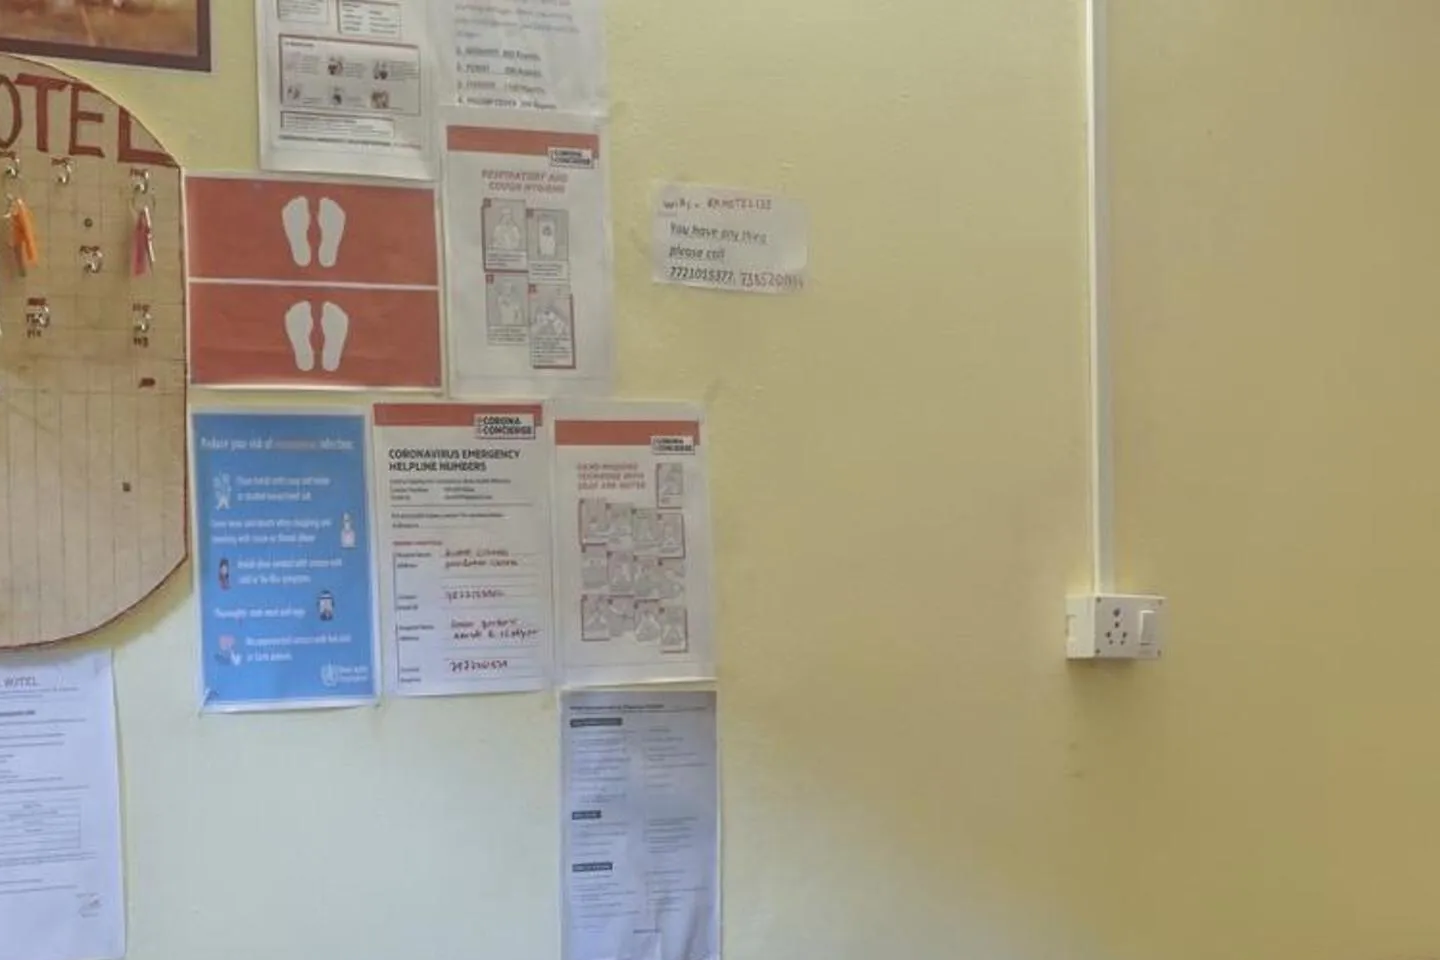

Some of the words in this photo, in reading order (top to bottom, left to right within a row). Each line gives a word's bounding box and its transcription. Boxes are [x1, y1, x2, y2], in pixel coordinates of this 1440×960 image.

[388, 448, 460, 460] CORONAVIRUS
[462, 449, 521, 460] EMERGENCY
[388, 461, 437, 472] HELPLINE
[439, 461, 487, 472] NUMBERS
